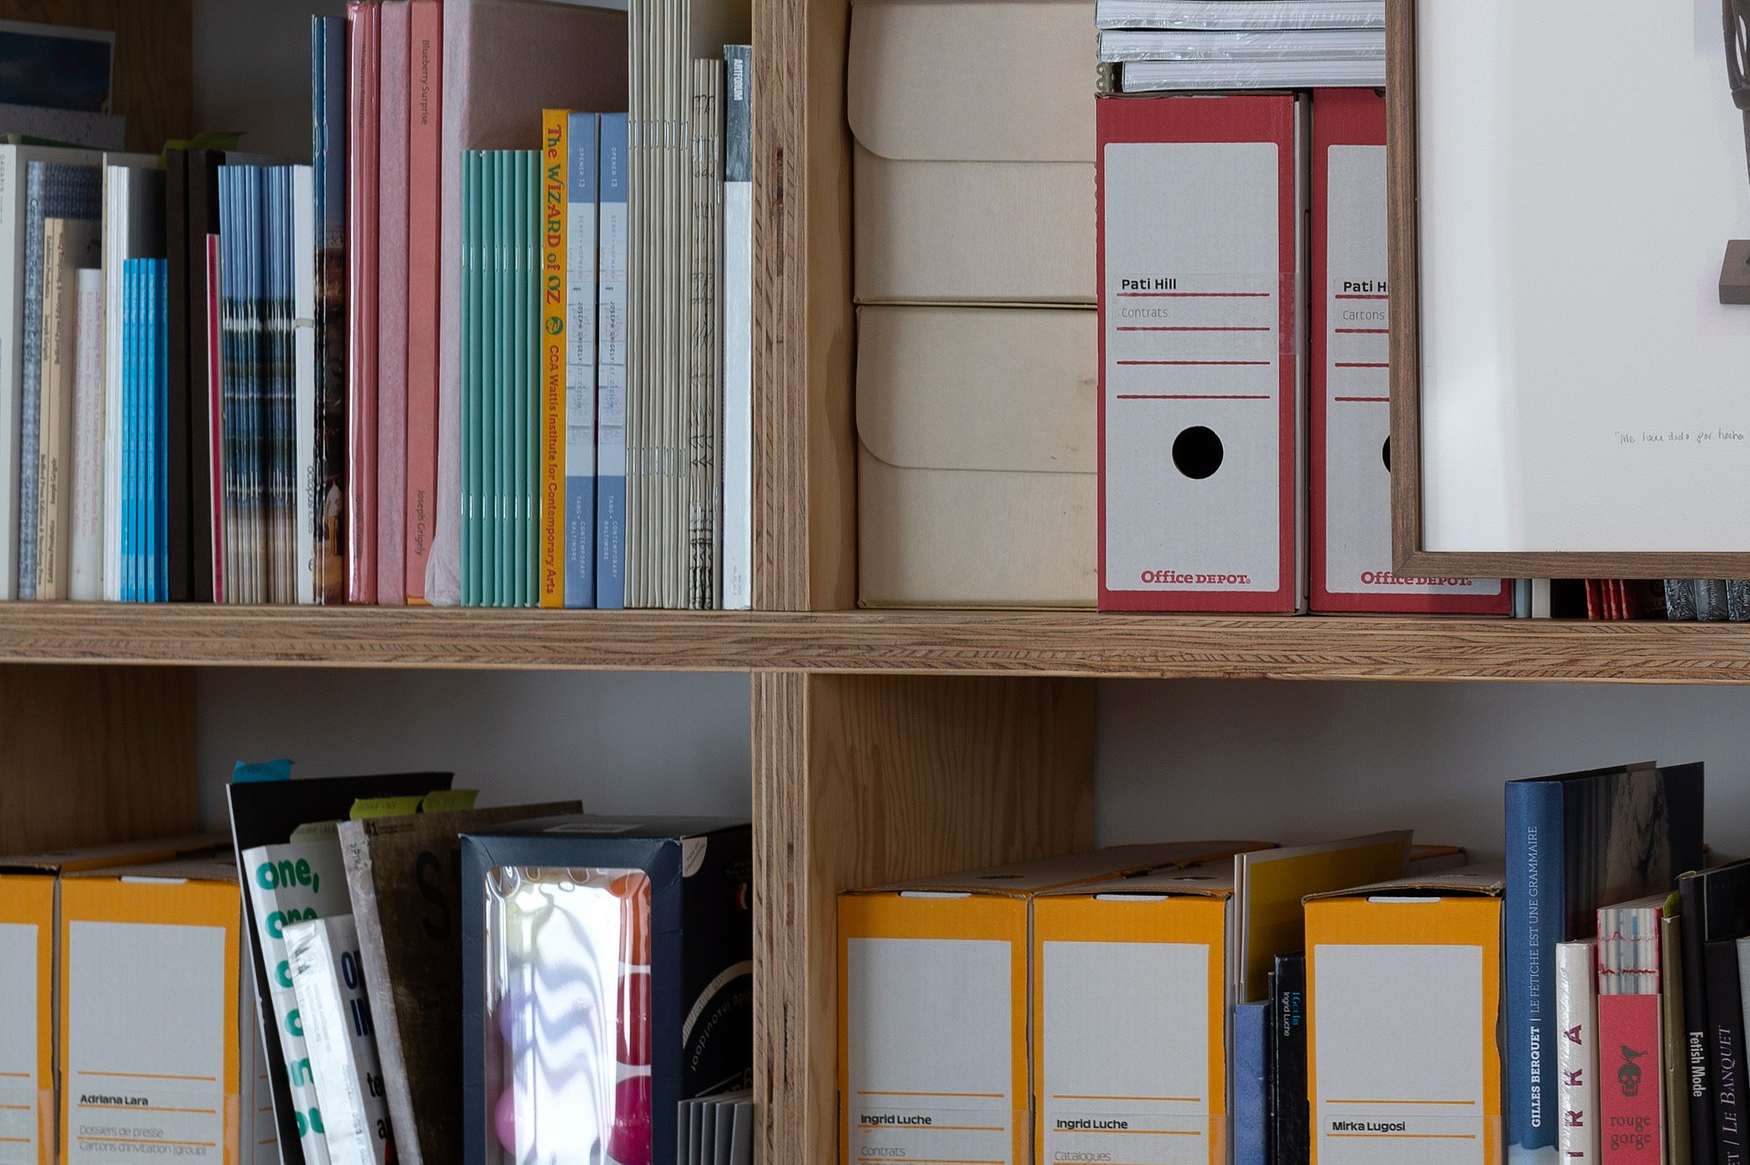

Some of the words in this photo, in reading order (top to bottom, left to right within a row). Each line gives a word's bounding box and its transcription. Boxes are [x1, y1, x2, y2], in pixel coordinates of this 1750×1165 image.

[547, 124, 562, 158] The
[547, 163, 565, 248] WIZARD
[547, 252, 560, 270] of
[546, 275, 561, 305] OZ
[1122, 279, 1150, 290] Pati
[1155, 279, 1176, 290] Hill
[1122, 307, 1168, 317] Contrats
[549, 345, 560, 372] CCA
[548, 374, 559, 412] Wattis
[548, 413, 559, 461] Institute
[547, 464, 559, 480] for
[545, 482, 558, 569] Contemporary
[546, 570, 556, 595] Arts
[1141, 570, 1193, 584] Office
[1196, 574, 1247, 584] DEPOT
[1530, 1026, 1541, 1084] BERQUET
[1690, 1031, 1705, 1064] Fetish
[1719, 1025, 1736, 1106] BANQUET
[1692, 1066, 1707, 1097] Mode
[80, 1093, 123, 1106] Adriana
[125, 1095, 149, 1106] Lara
[1531, 1085, 1541, 1128] GILLES
[861, 1115, 895, 1126] Ingrid
[897, 1115, 931, 1124] Luche
[1332, 1121, 1365, 1131] Mirka
[1367, 1121, 1405, 1132] Lugosi
[1610, 1114, 1652, 1133] rouge
[1610, 1133, 1652, 1151] gorge
